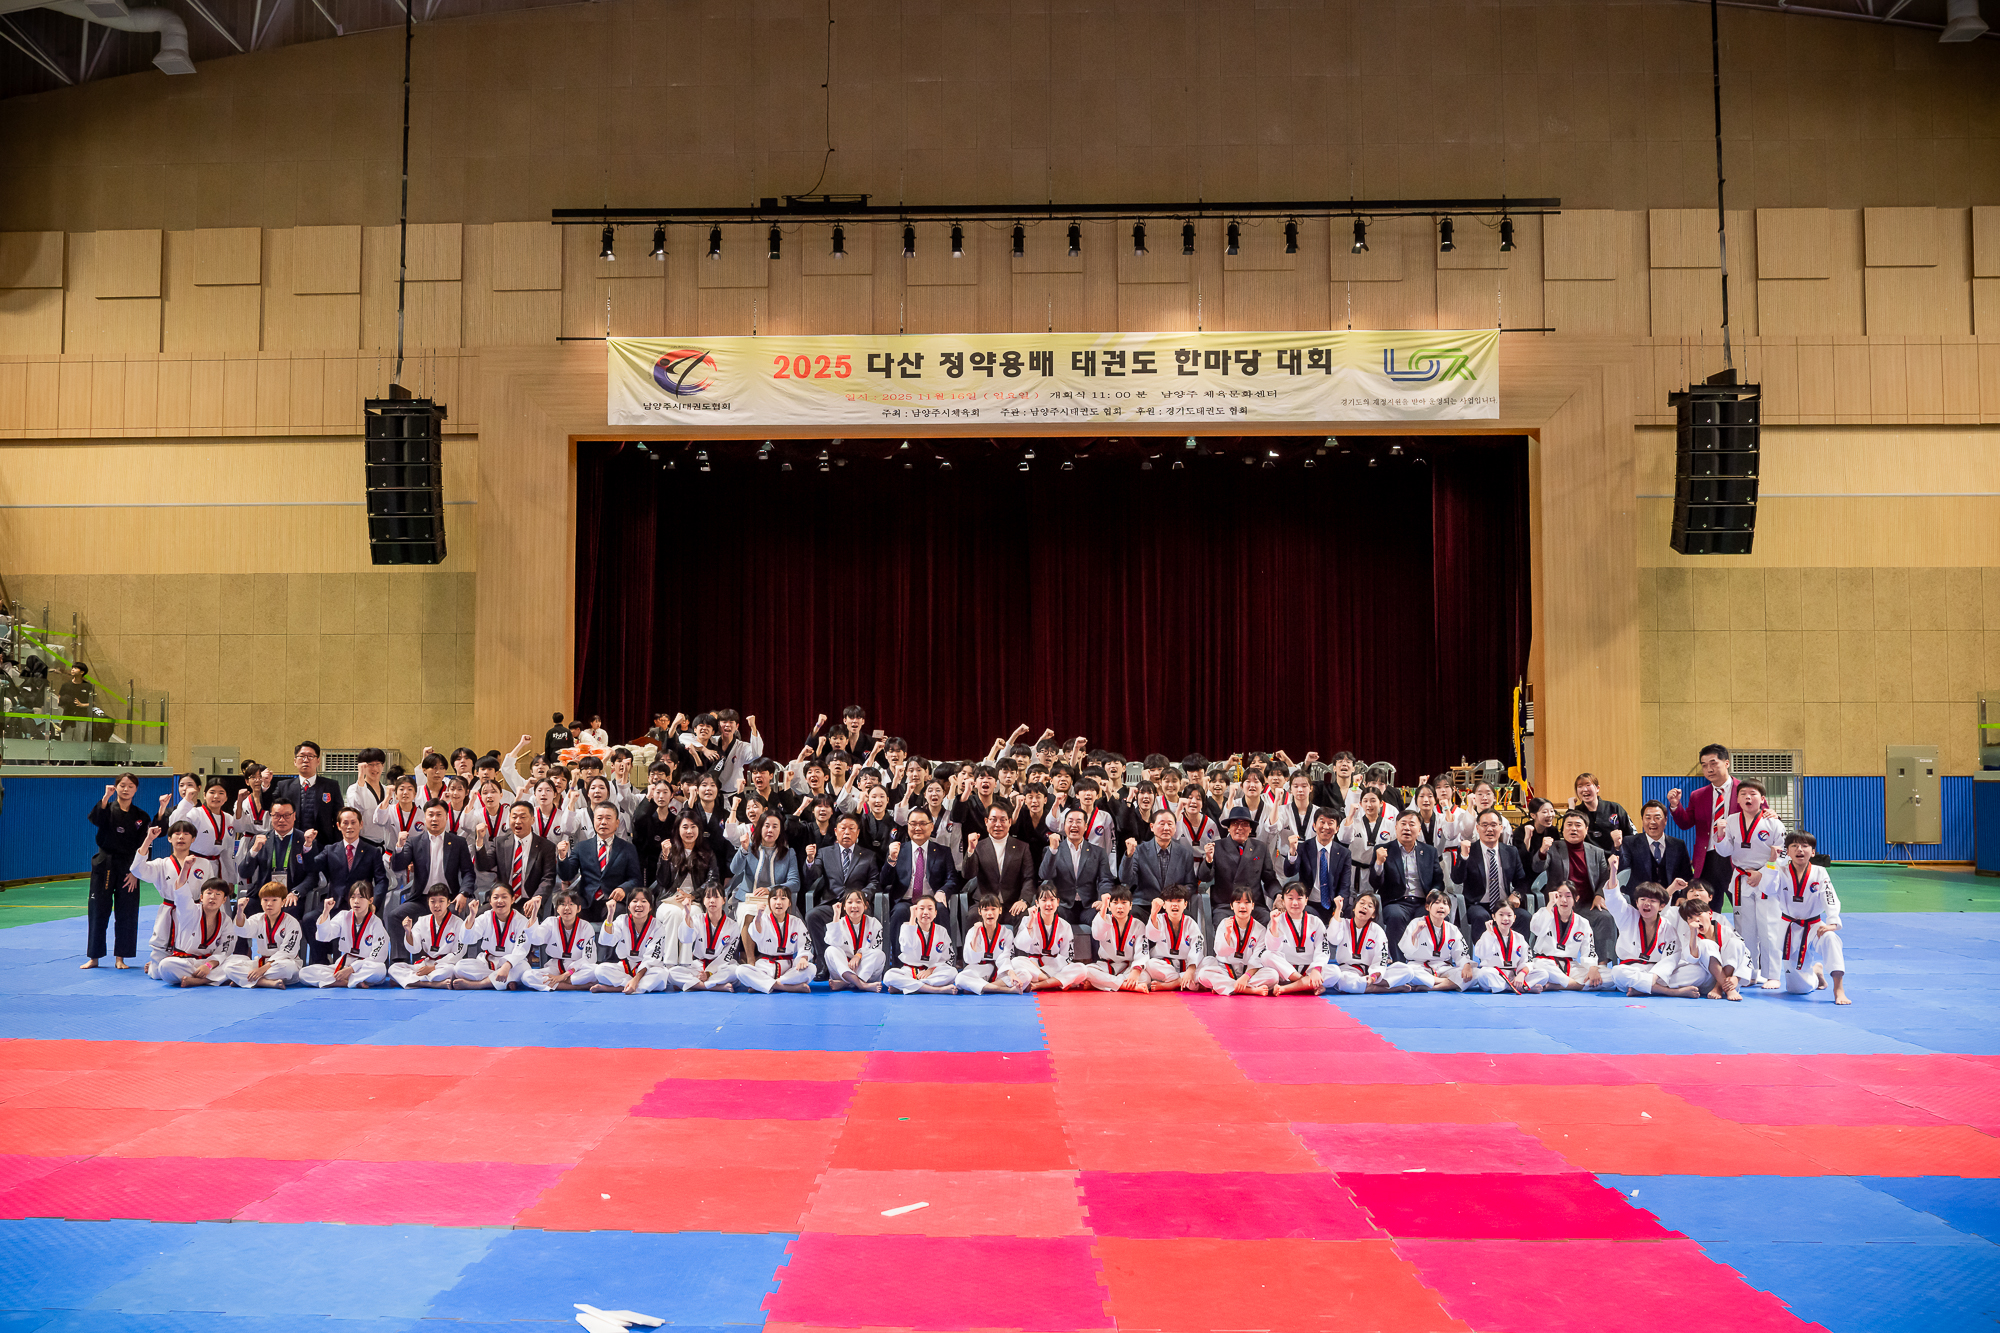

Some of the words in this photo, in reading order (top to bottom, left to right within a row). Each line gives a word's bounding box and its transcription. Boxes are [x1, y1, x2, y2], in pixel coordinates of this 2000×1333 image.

[773, 354, 852, 379] 2025
[867, 352, 925, 379] 다산
[939, 350, 1054, 379] 정약용배
[1071, 350, 1158, 377] 태권도
[1174, 348, 1262, 376] 한마당
[1277, 347, 1332, 376] 대회
[882, 393, 913, 401] 2025
[918, 392, 945, 401] 11월
[951, 392, 977, 401] 16일
[1161, 391, 1199, 399] 남양주
[1203, 390, 1278, 399] 체육문화센터
[643, 402, 731, 411] 남양주시태권도협회
[1135, 407, 1155, 416] 후원
[1165, 407, 1225, 416] 경기도태권도
[1229, 406, 1248, 416] 협회
[911, 409, 981, 418] 남양주시체육회
[1000, 409, 1020, 417] 주관
[1030, 407, 1099, 417] 남양주시태권도
[1103, 407, 1122, 416] 협회
